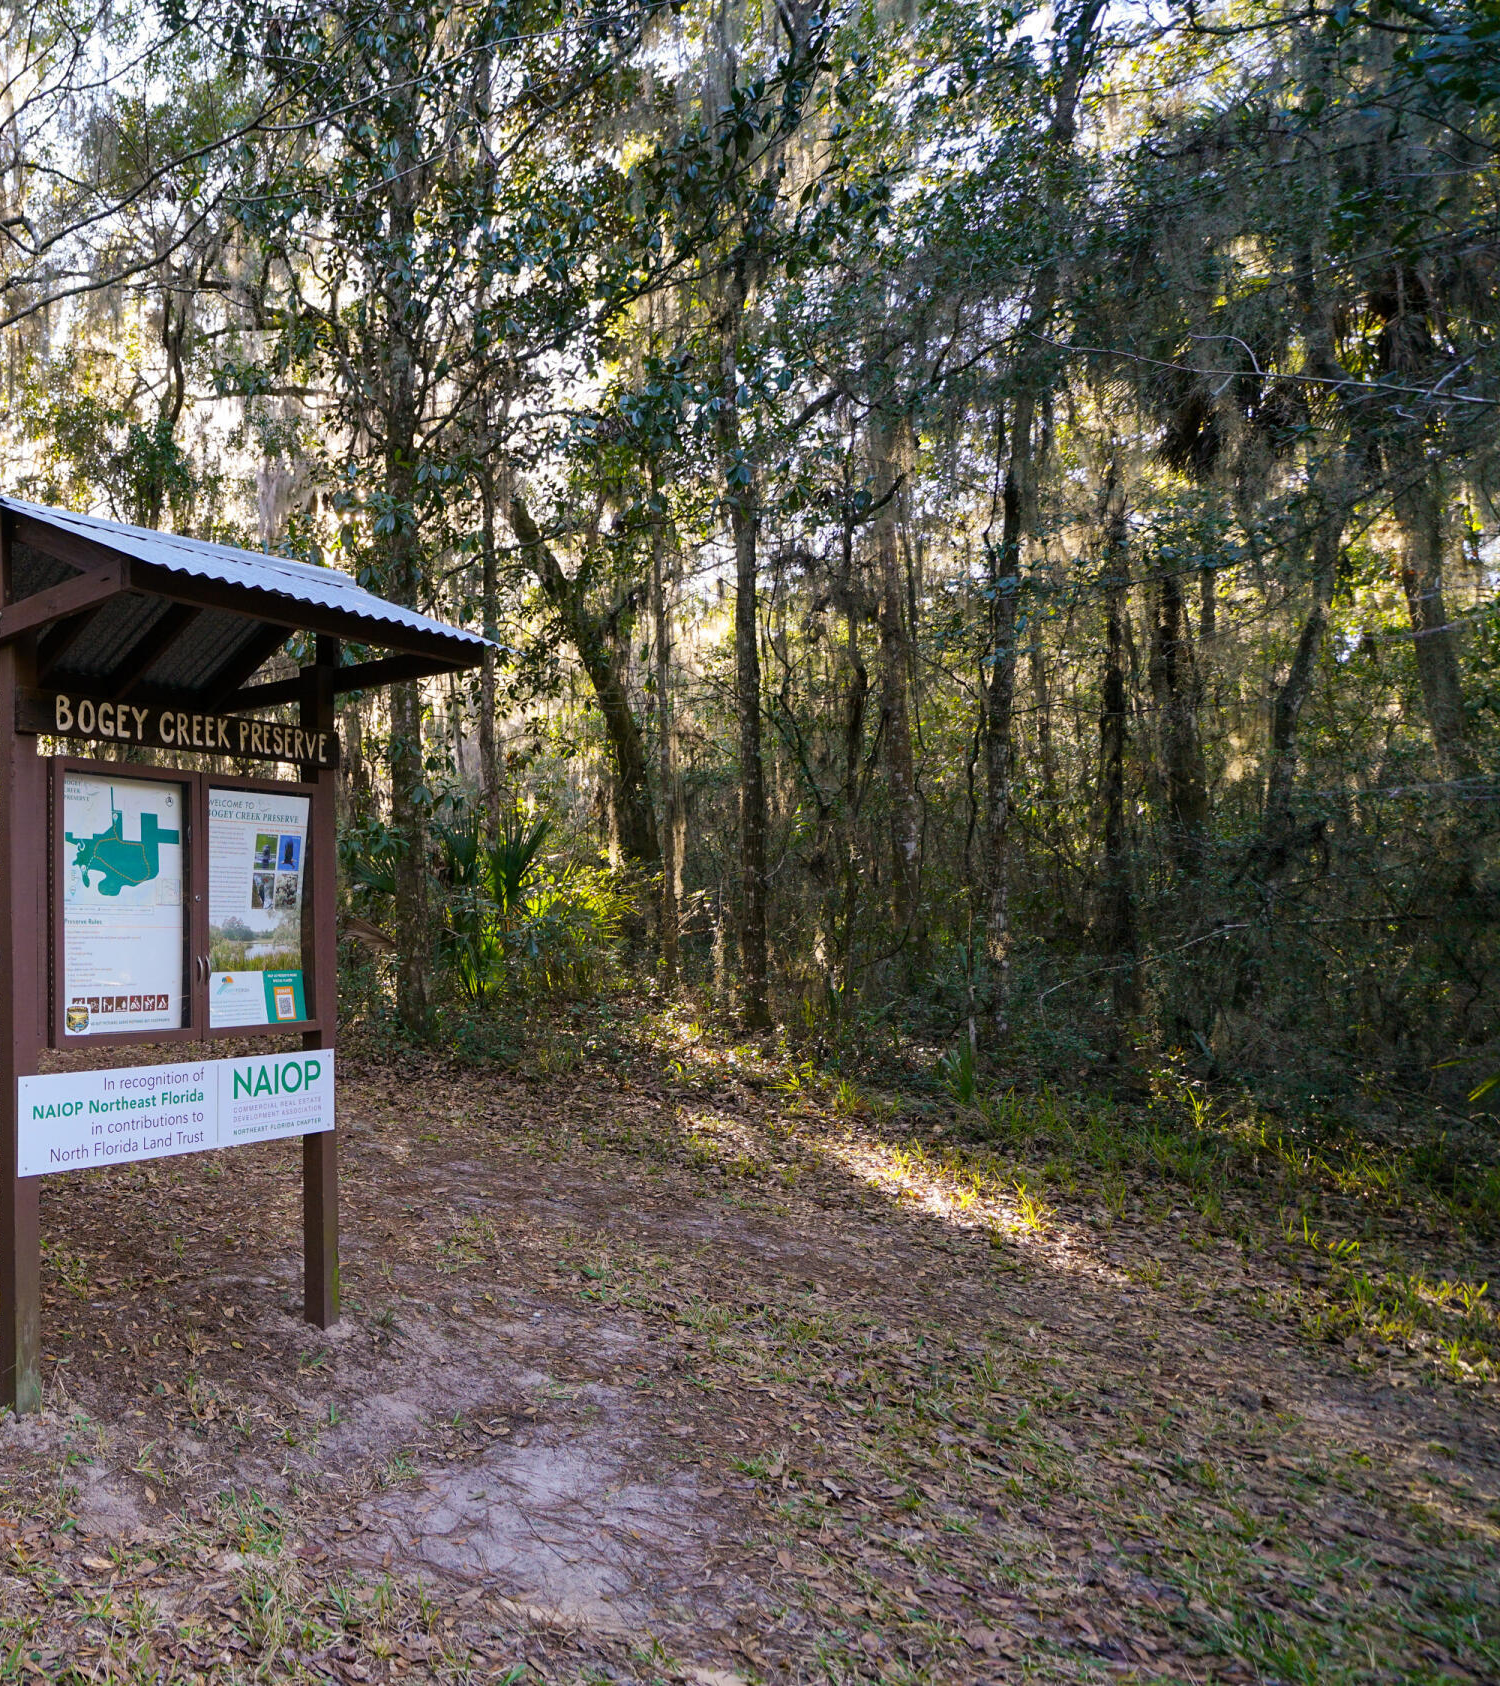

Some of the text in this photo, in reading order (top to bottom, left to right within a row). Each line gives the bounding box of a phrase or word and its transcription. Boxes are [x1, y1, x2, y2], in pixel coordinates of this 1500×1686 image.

[55, 694, 328, 763] BOGEY CREEK PRESERVE
[236, 811, 261, 821] CREEK
[262, 813, 299, 824] PRESERVE
[245, 801, 255, 810] TO
[104, 1066, 205, 1091] In recognition of
[233, 1060, 321, 1100] NAIOP
[32, 1088, 204, 1120] NAIOP Northeast Florida
[233, 1096, 322, 1114] COMMERCIAL REAL ESTATE
[233, 1105, 322, 1123] DEVELOPMENT ASSOCIATION
[91, 1112, 204, 1136] in contributions to
[233, 1117, 321, 1136] NORTHEAST FLORIDA CHAPTER
[50, 1130, 204, 1163] North Florida Land Trust
